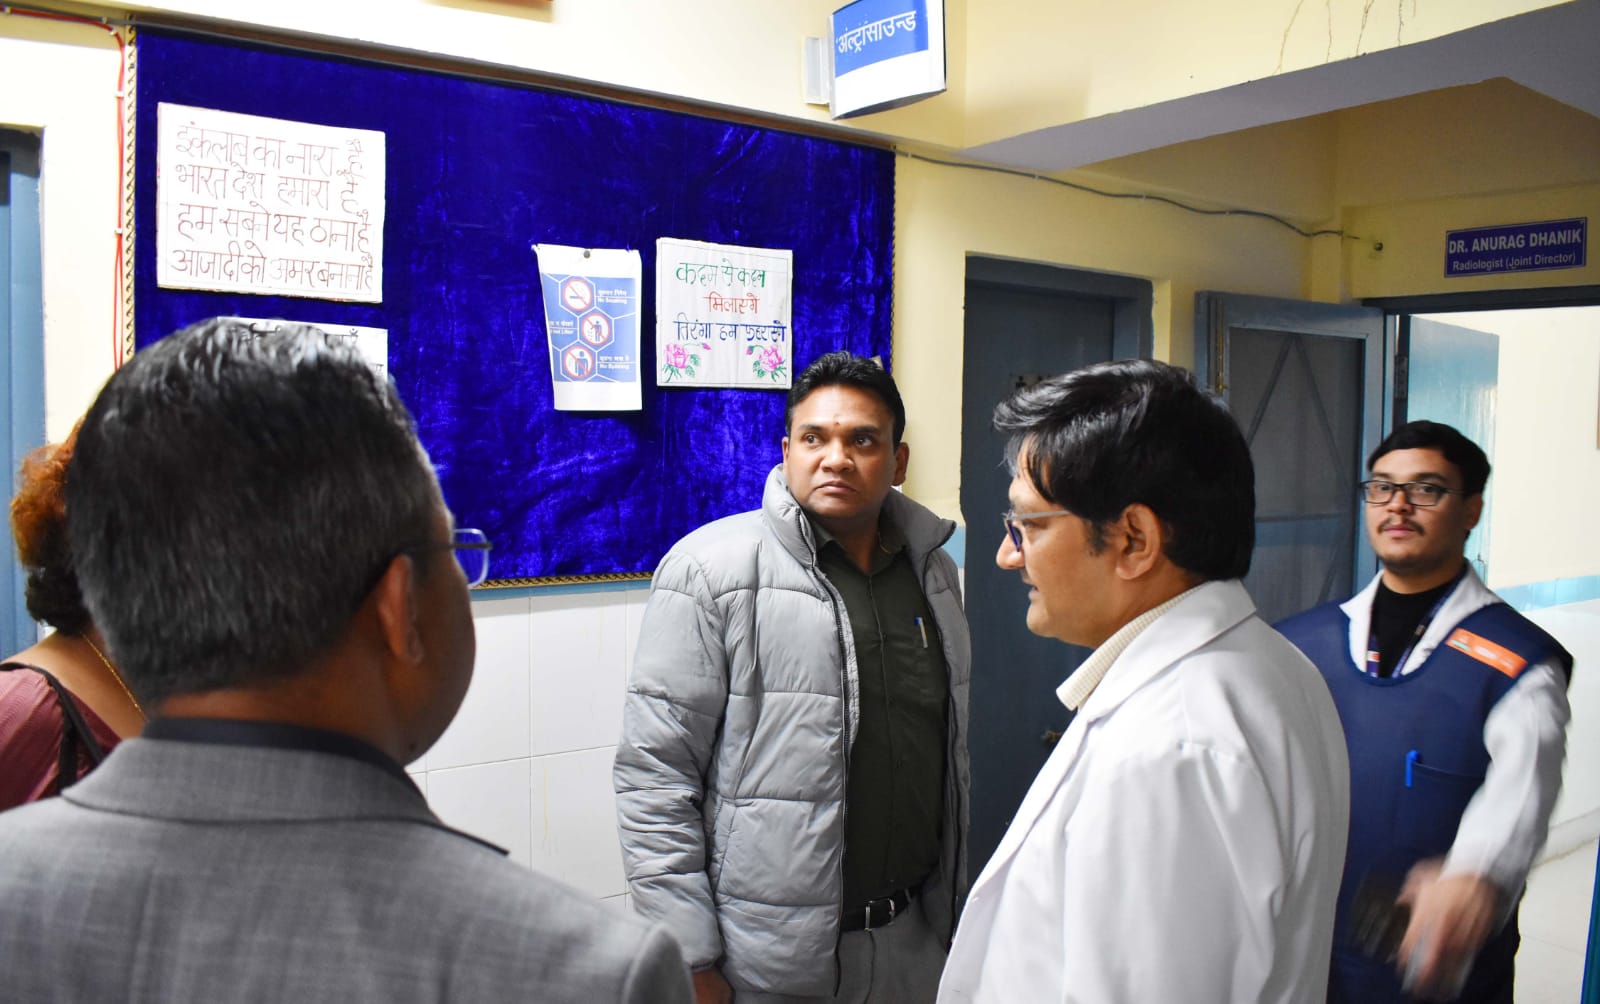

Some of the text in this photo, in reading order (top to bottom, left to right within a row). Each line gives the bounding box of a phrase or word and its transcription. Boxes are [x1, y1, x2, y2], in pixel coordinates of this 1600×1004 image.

[253, 136, 286, 170] का
[285, 143, 340, 177] नारा
[175, 164, 230, 200] भारत
[231, 161, 266, 200] देश
[277, 175, 330, 210] हमारा
[177, 202, 219, 241] हम
[273, 213, 306, 247] यह
[1448, 228, 1582, 254] DR. ANURAG DHANIK
[1452, 250, 1577, 272] Radiologist (Joint Director)
